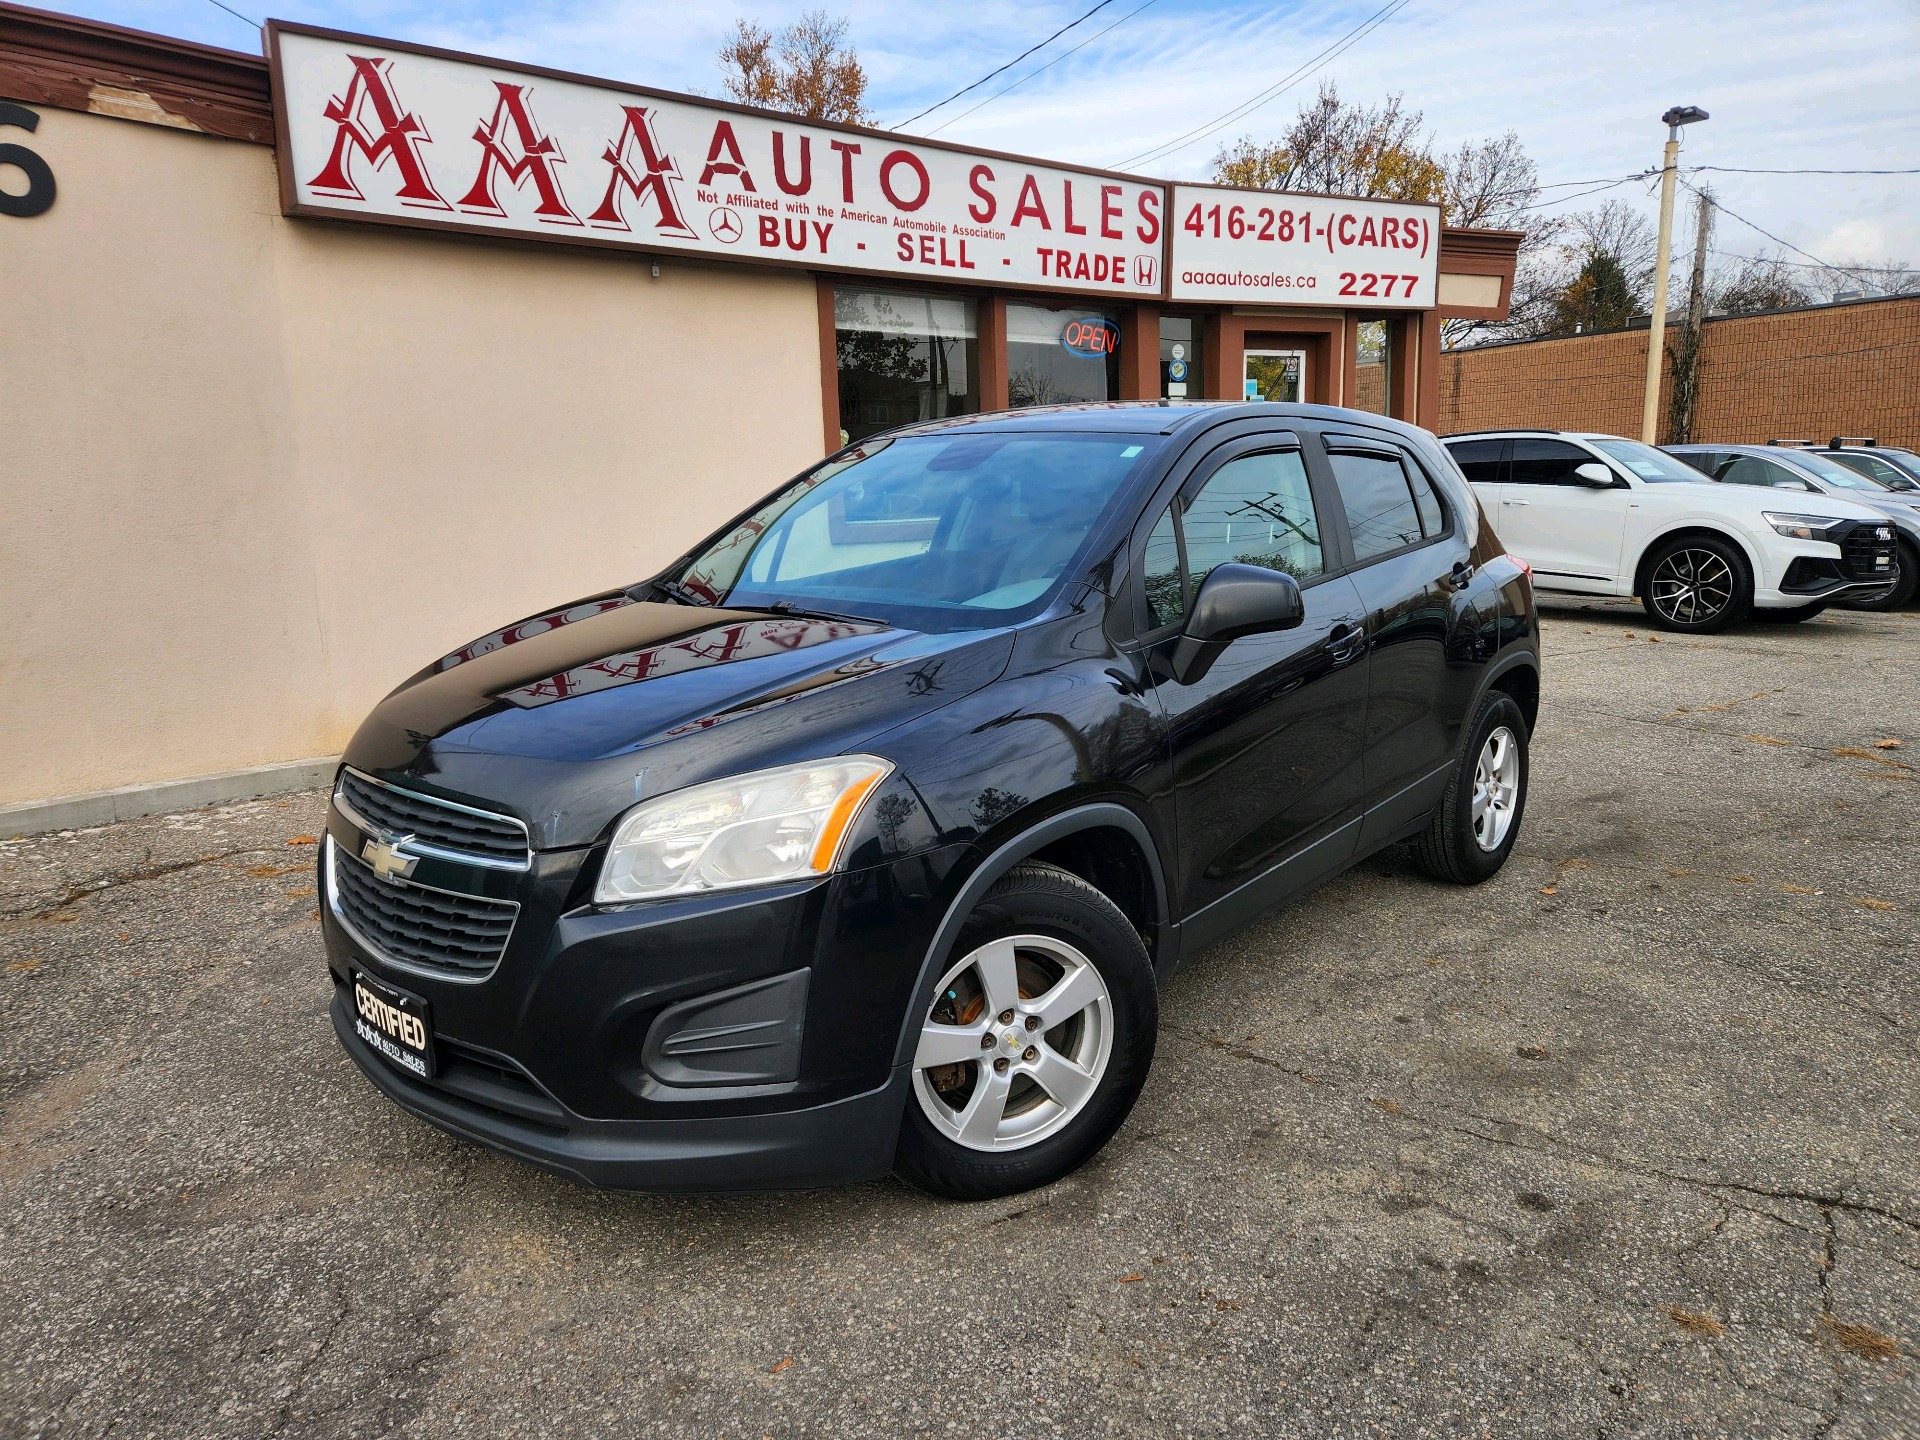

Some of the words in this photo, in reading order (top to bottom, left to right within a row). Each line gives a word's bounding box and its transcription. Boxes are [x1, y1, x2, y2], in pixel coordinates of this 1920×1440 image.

[0, 103, 57, 217] 6
[699, 119, 931, 213] AUTO
[968, 164, 1160, 245] SALES
[697, 189, 718, 204] Not
[726, 193, 779, 211] Affiliated
[786, 202, 810, 215] with
[817, 205, 834, 218] the
[840, 207, 888, 225] American
[893, 216, 947, 234] Automobile
[952, 223, 1006, 241] Association
[1184, 202, 1430, 258] 416-281-(CARS)
[758, 214, 834, 254] BUY
[897, 232, 975, 270] SELL
[1037, 248, 1126, 284] TRADE
[1182, 270, 1317, 289] aaaautosales.ca
[1339, 272, 1419, 298] 2277
[1066, 322, 1117, 353] OPEN
[355, 983, 426, 1051] CERTIFIED
[402, 1050, 426, 1072] SALES
